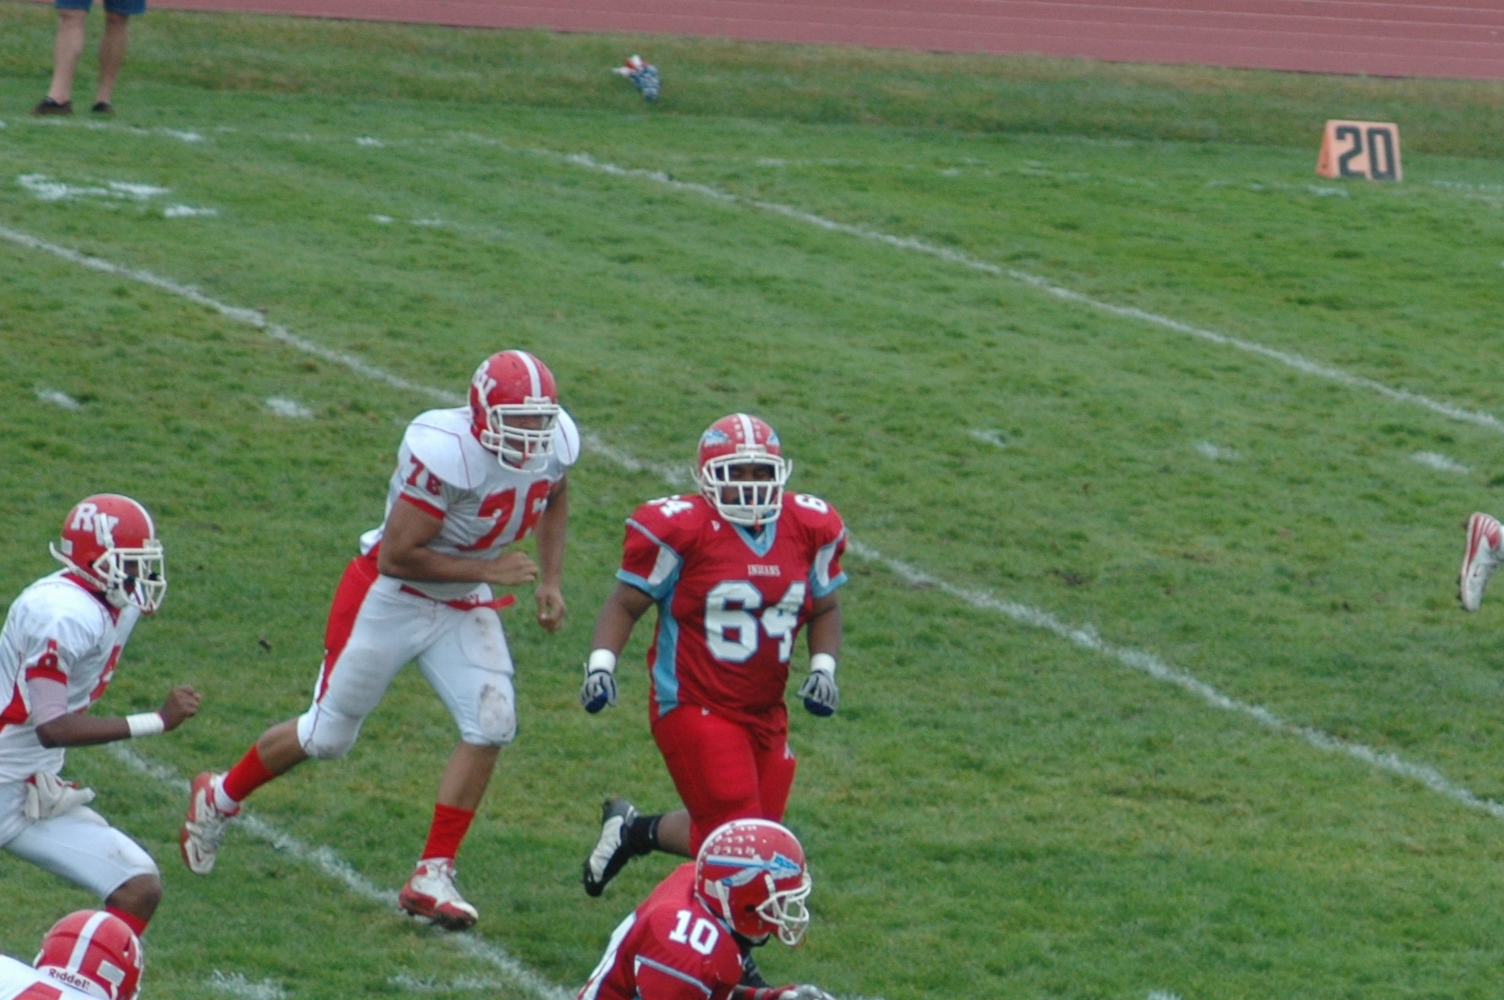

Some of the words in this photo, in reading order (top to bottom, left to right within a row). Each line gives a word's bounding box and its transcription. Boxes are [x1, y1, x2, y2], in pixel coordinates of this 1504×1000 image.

[1335, 126, 1396, 181] 20
[747, 564, 781, 577] INDIANS
[705, 580, 807, 664] 64
[669, 910, 720, 955] 10
